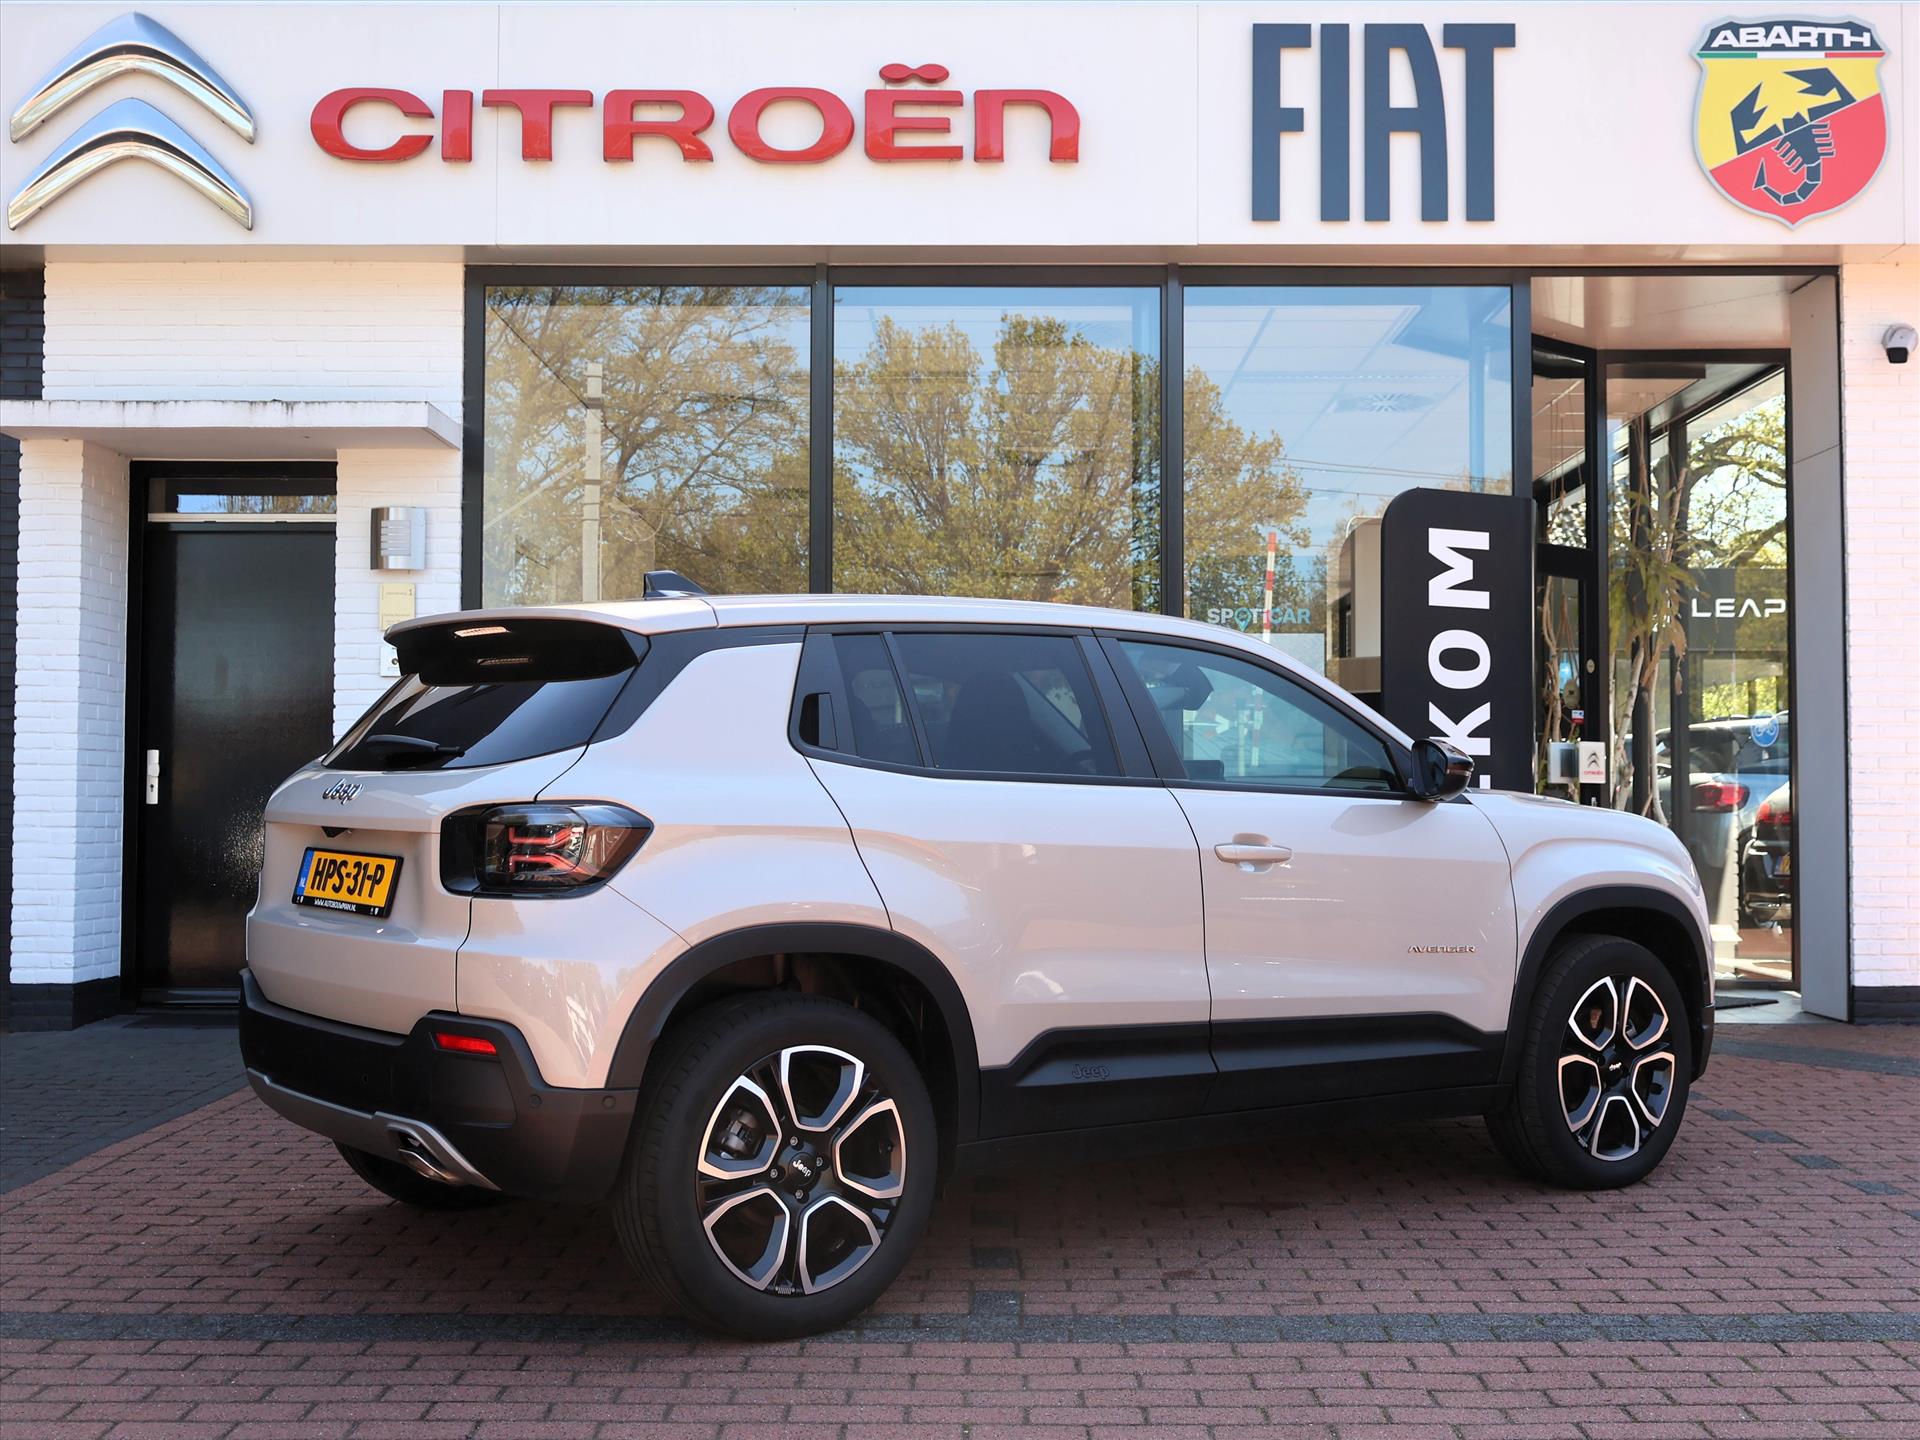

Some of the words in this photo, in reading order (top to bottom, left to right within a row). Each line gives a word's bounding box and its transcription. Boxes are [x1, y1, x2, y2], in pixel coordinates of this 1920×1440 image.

[1710, 25, 1872, 48] ABARTH
[1252, 23, 1516, 221] FIAT
[1691, 598, 1787, 618] LEAP
[1428, 527, 1492, 789] KOM
[322, 778, 364, 804] Jeep
[310, 857, 386, 899] HPS-31-P
[1407, 945, 1476, 954] AVENGER
[1072, 1063, 1111, 1080] Jeep
[792, 1159, 812, 1178] Jeep
